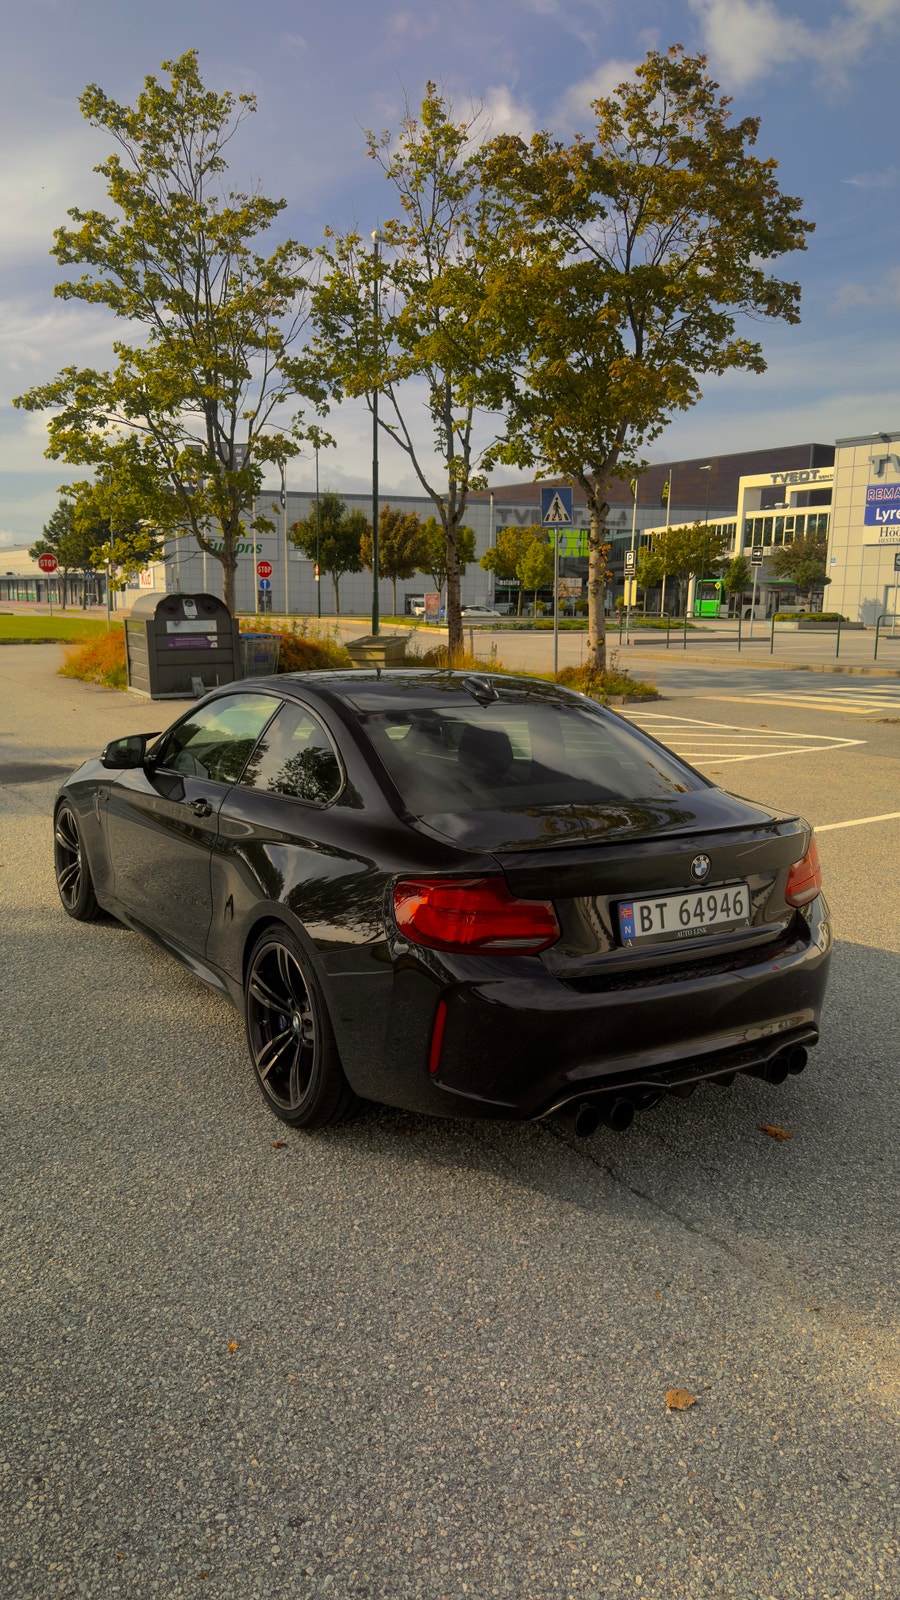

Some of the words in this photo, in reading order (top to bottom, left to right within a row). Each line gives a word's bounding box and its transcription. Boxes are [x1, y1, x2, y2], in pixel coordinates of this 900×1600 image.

[770, 469, 820, 484] TVEDT
[867, 486, 900, 501] REMA
[40, 559, 57, 567] STOP
[257, 565, 272, 573] STOP
[639, 902, 668, 933] BT
[679, 890, 743, 926] 64946
[624, 925, 632, 934] N
[676, 930, 693, 938] AUTO
[693, 928, 708, 936] LINK
